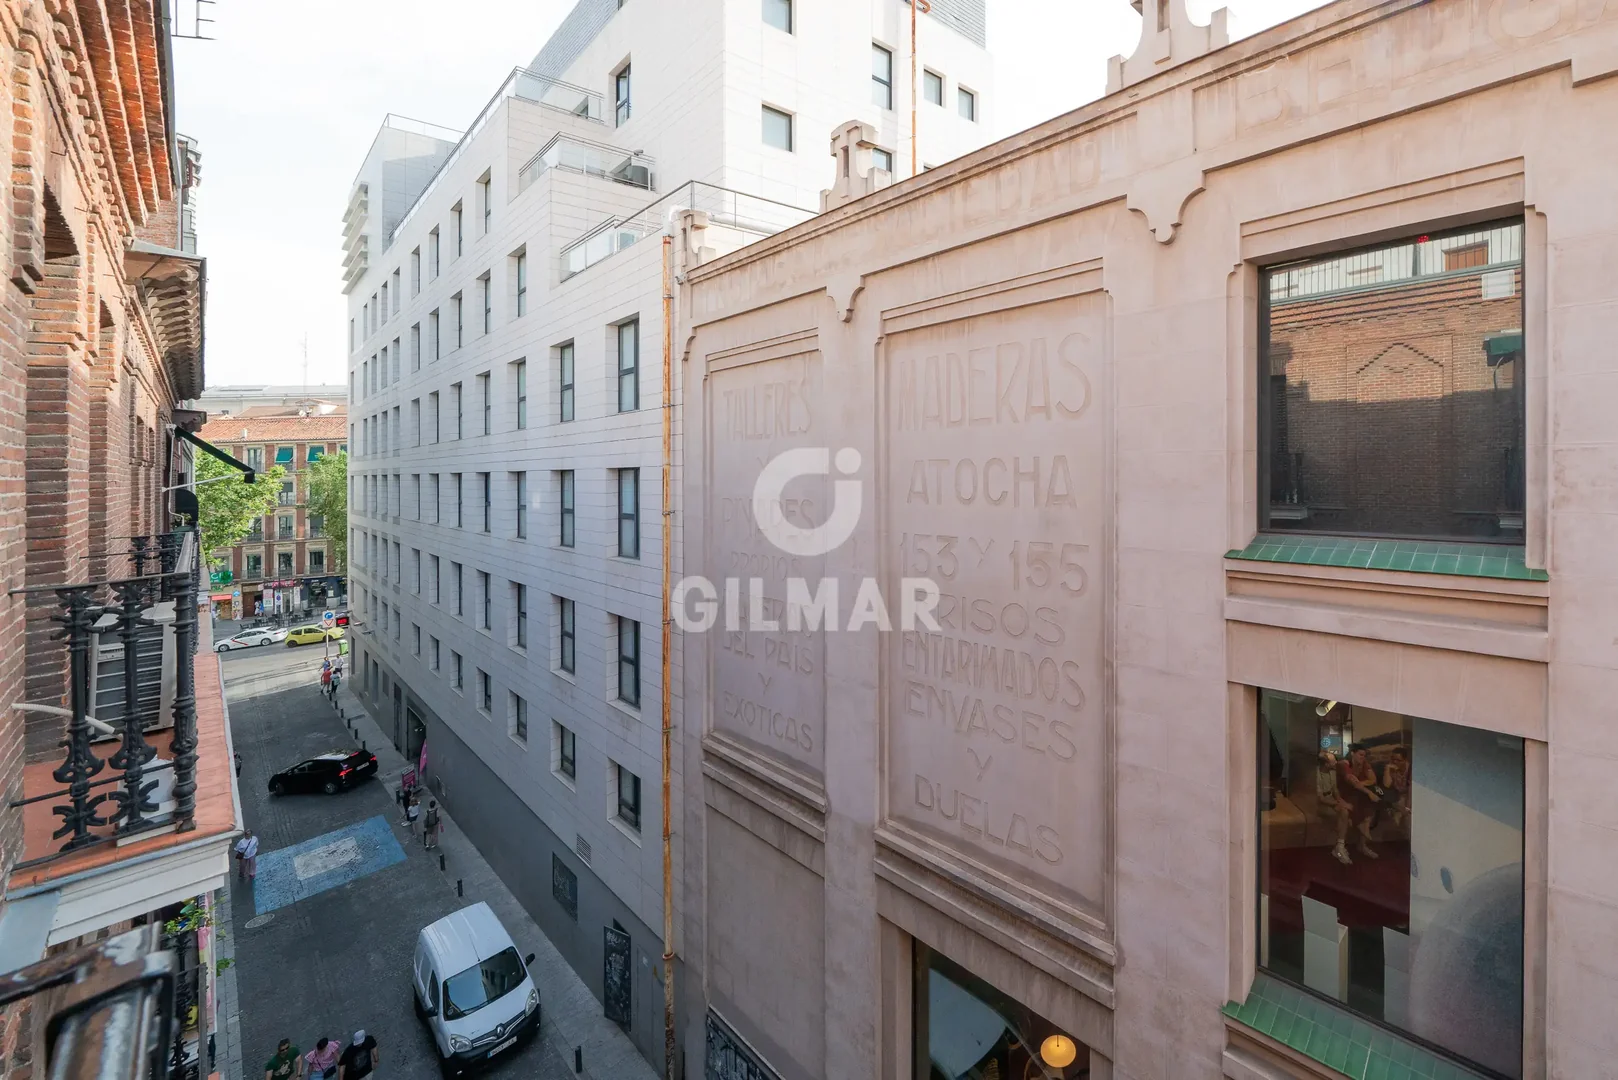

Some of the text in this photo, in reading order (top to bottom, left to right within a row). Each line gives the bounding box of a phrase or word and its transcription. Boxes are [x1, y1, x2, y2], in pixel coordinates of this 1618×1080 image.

[723, 378, 812, 441] TALLERES
[898, 332, 1092, 430] MADERAS
[906, 455, 1078, 509] ATOCHA
[900, 532, 1090, 598] 153 Y 155
[723, 628, 755, 660] DEL
[902, 631, 1086, 712] ENTARIMADOS
[757, 672, 773, 696] Y
[723, 690, 814, 752] EXOTICAS
[905, 680, 1078, 763] ENVASES
[966, 747, 994, 782] Y
[914, 773, 1063, 867] DUELAS
